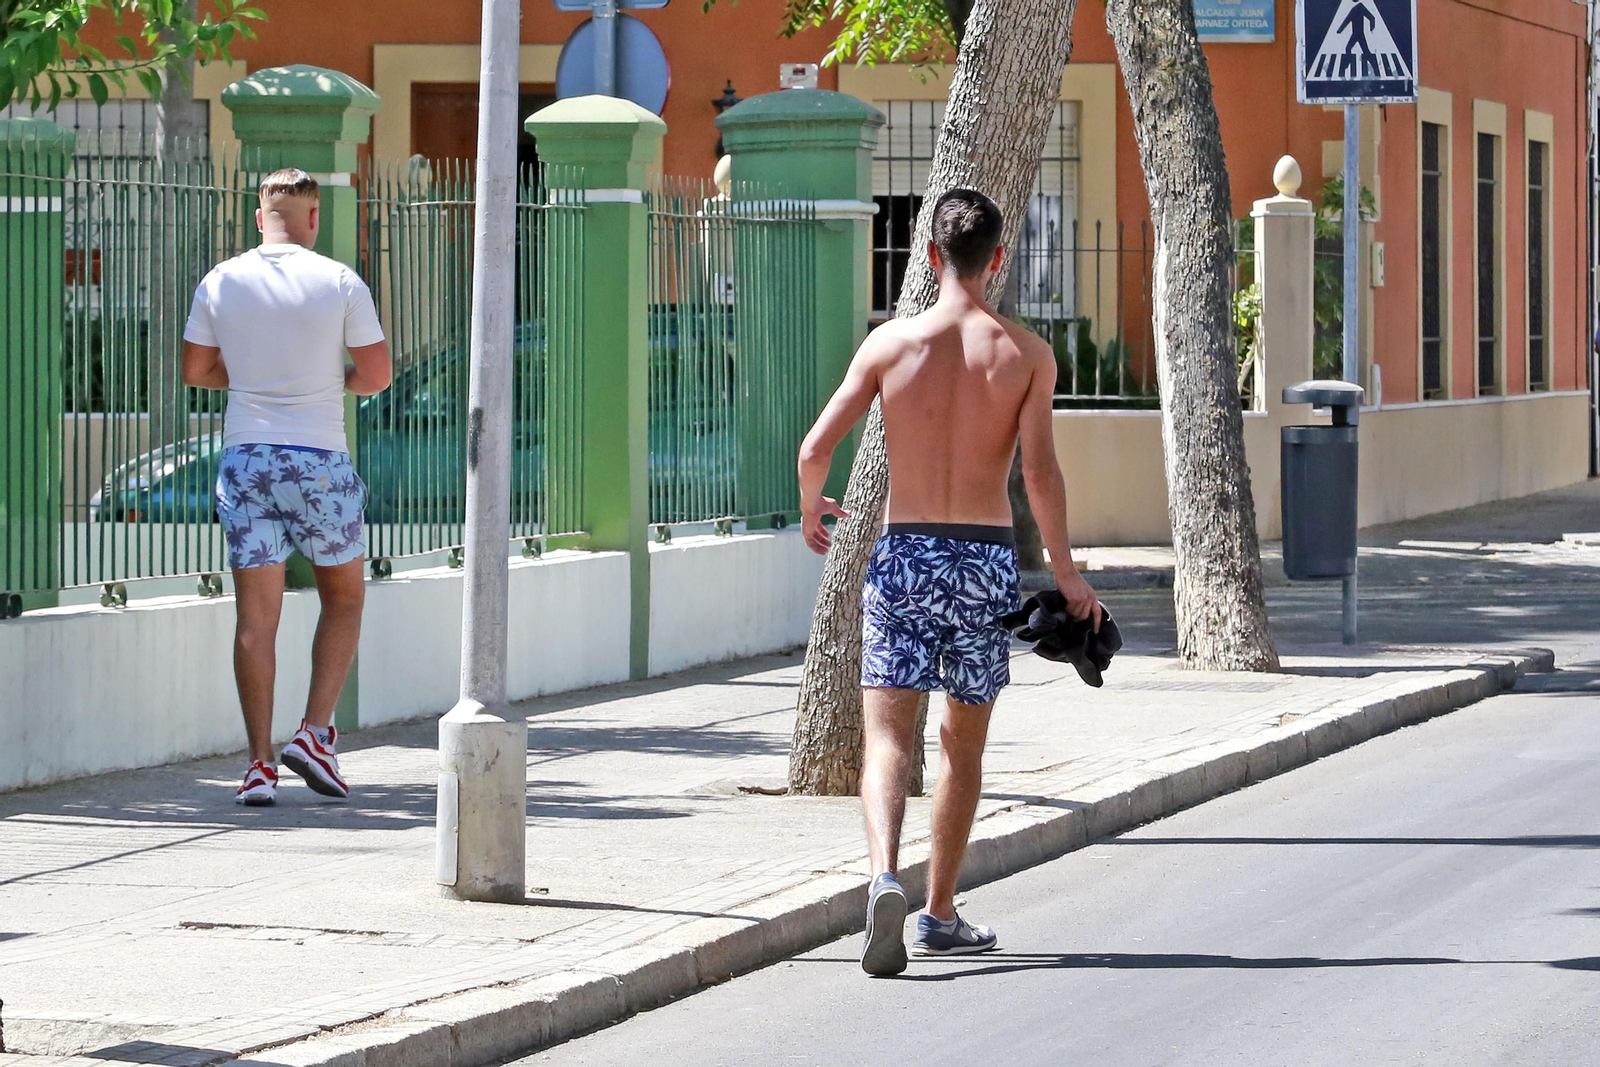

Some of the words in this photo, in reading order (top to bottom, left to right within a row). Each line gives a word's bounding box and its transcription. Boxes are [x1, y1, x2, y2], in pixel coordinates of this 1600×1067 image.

[1195, 8, 1236, 17] ALCALDE
[1240, 8, 1264, 17] JUAN
[1231, 19, 1269, 28] ORTEGA
